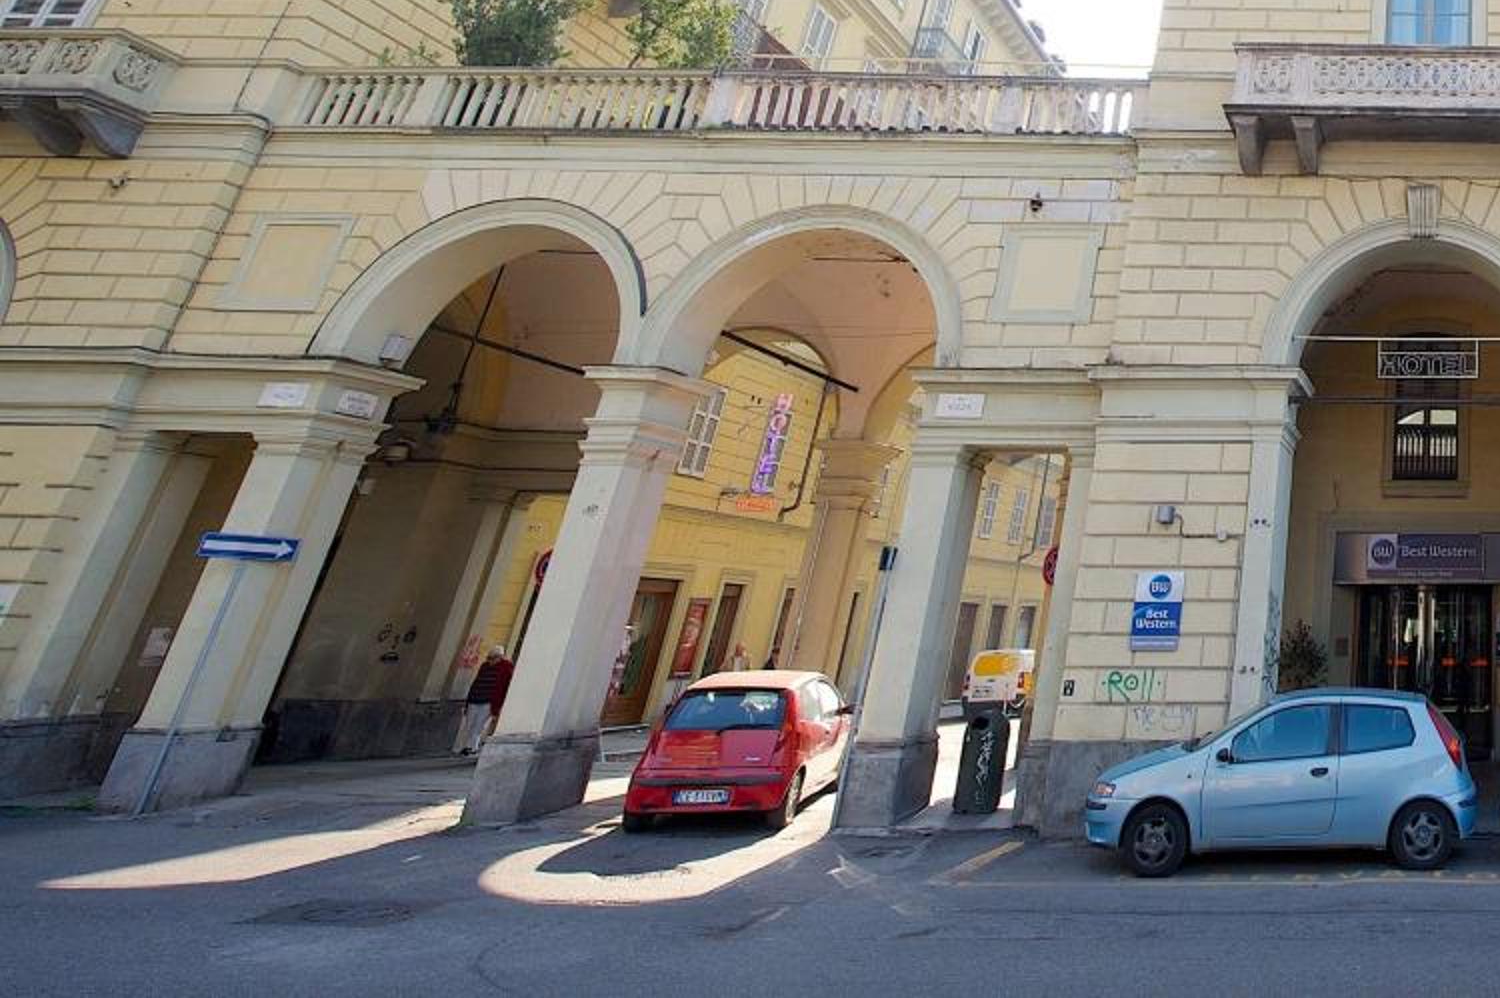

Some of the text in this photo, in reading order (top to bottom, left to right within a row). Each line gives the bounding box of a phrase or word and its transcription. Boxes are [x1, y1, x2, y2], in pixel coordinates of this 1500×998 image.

[1380, 354, 1474, 376] HOTEL
[1401, 545, 1427, 558] Best
[1429, 545, 1477, 558] Western
[1146, 608, 1168, 619] Best
[1135, 618, 1178, 629] Western
